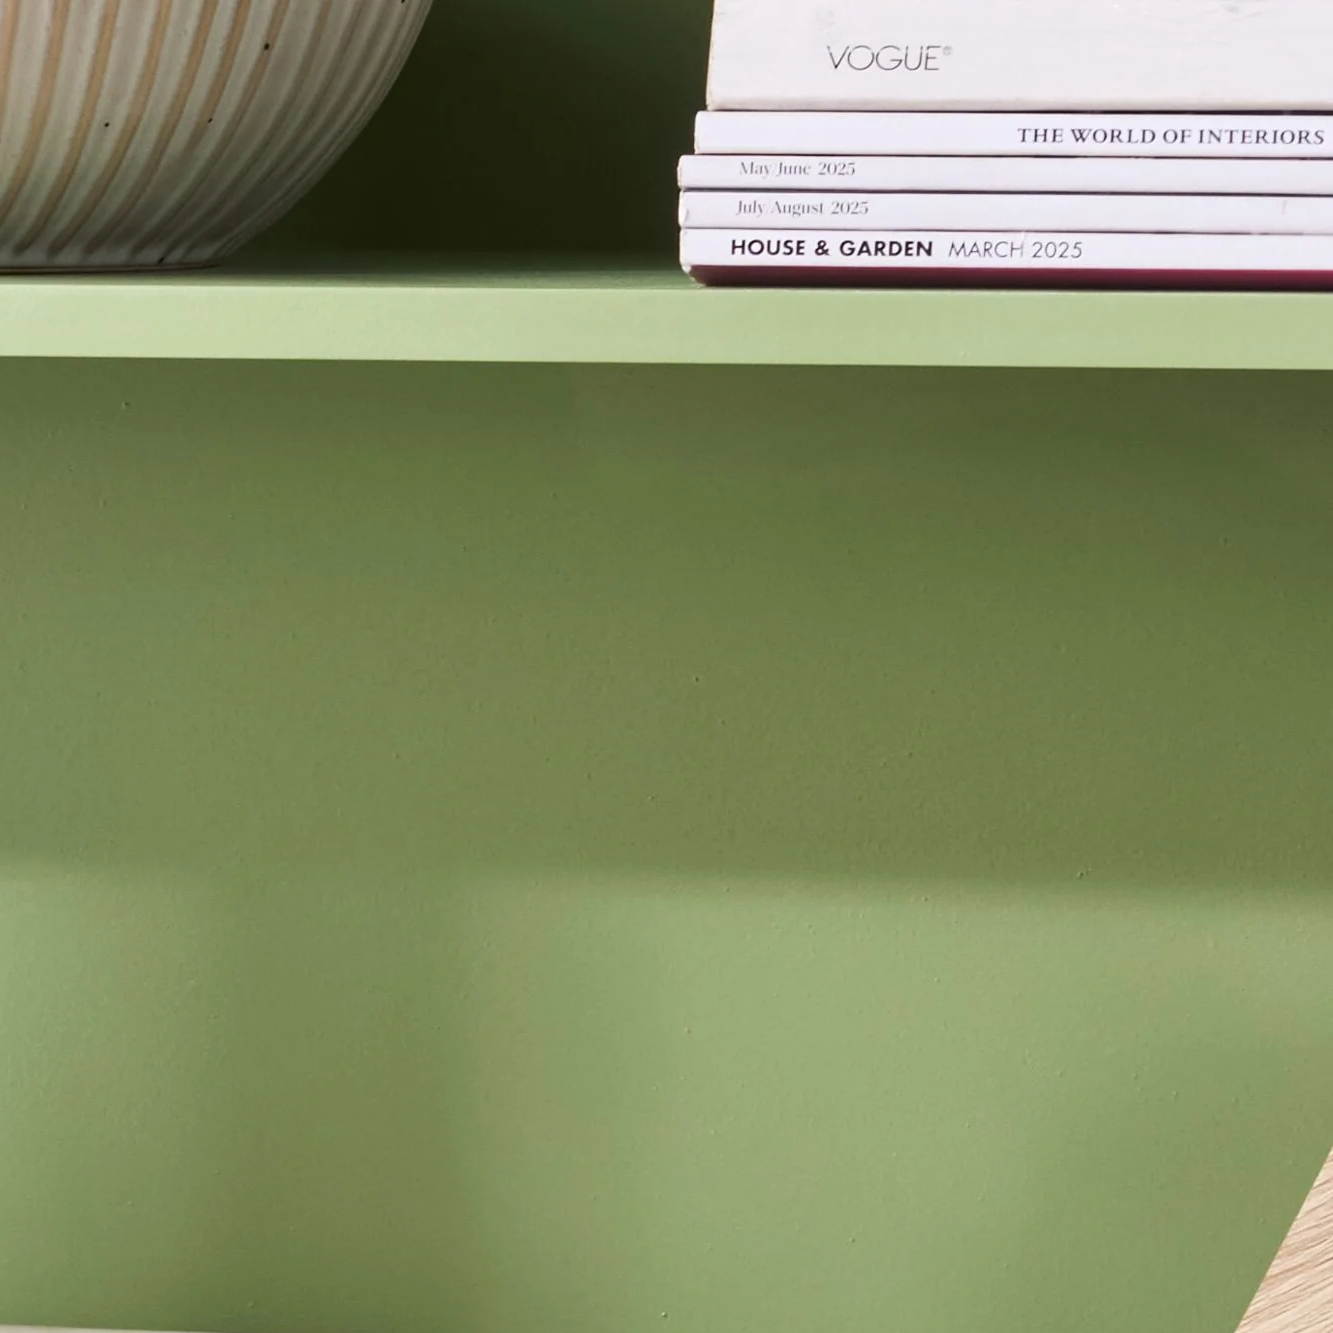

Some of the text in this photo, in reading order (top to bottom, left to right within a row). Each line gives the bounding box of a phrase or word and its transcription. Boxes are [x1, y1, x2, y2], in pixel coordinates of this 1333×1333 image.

[1017, 128, 1325, 145] THE WORLD OF INTERIORS
[818, 161, 856, 176] 2025
[831, 201, 869, 215] 2025
[731, 238, 1083, 259] HOUSE & GARDEN MARCH 2025
